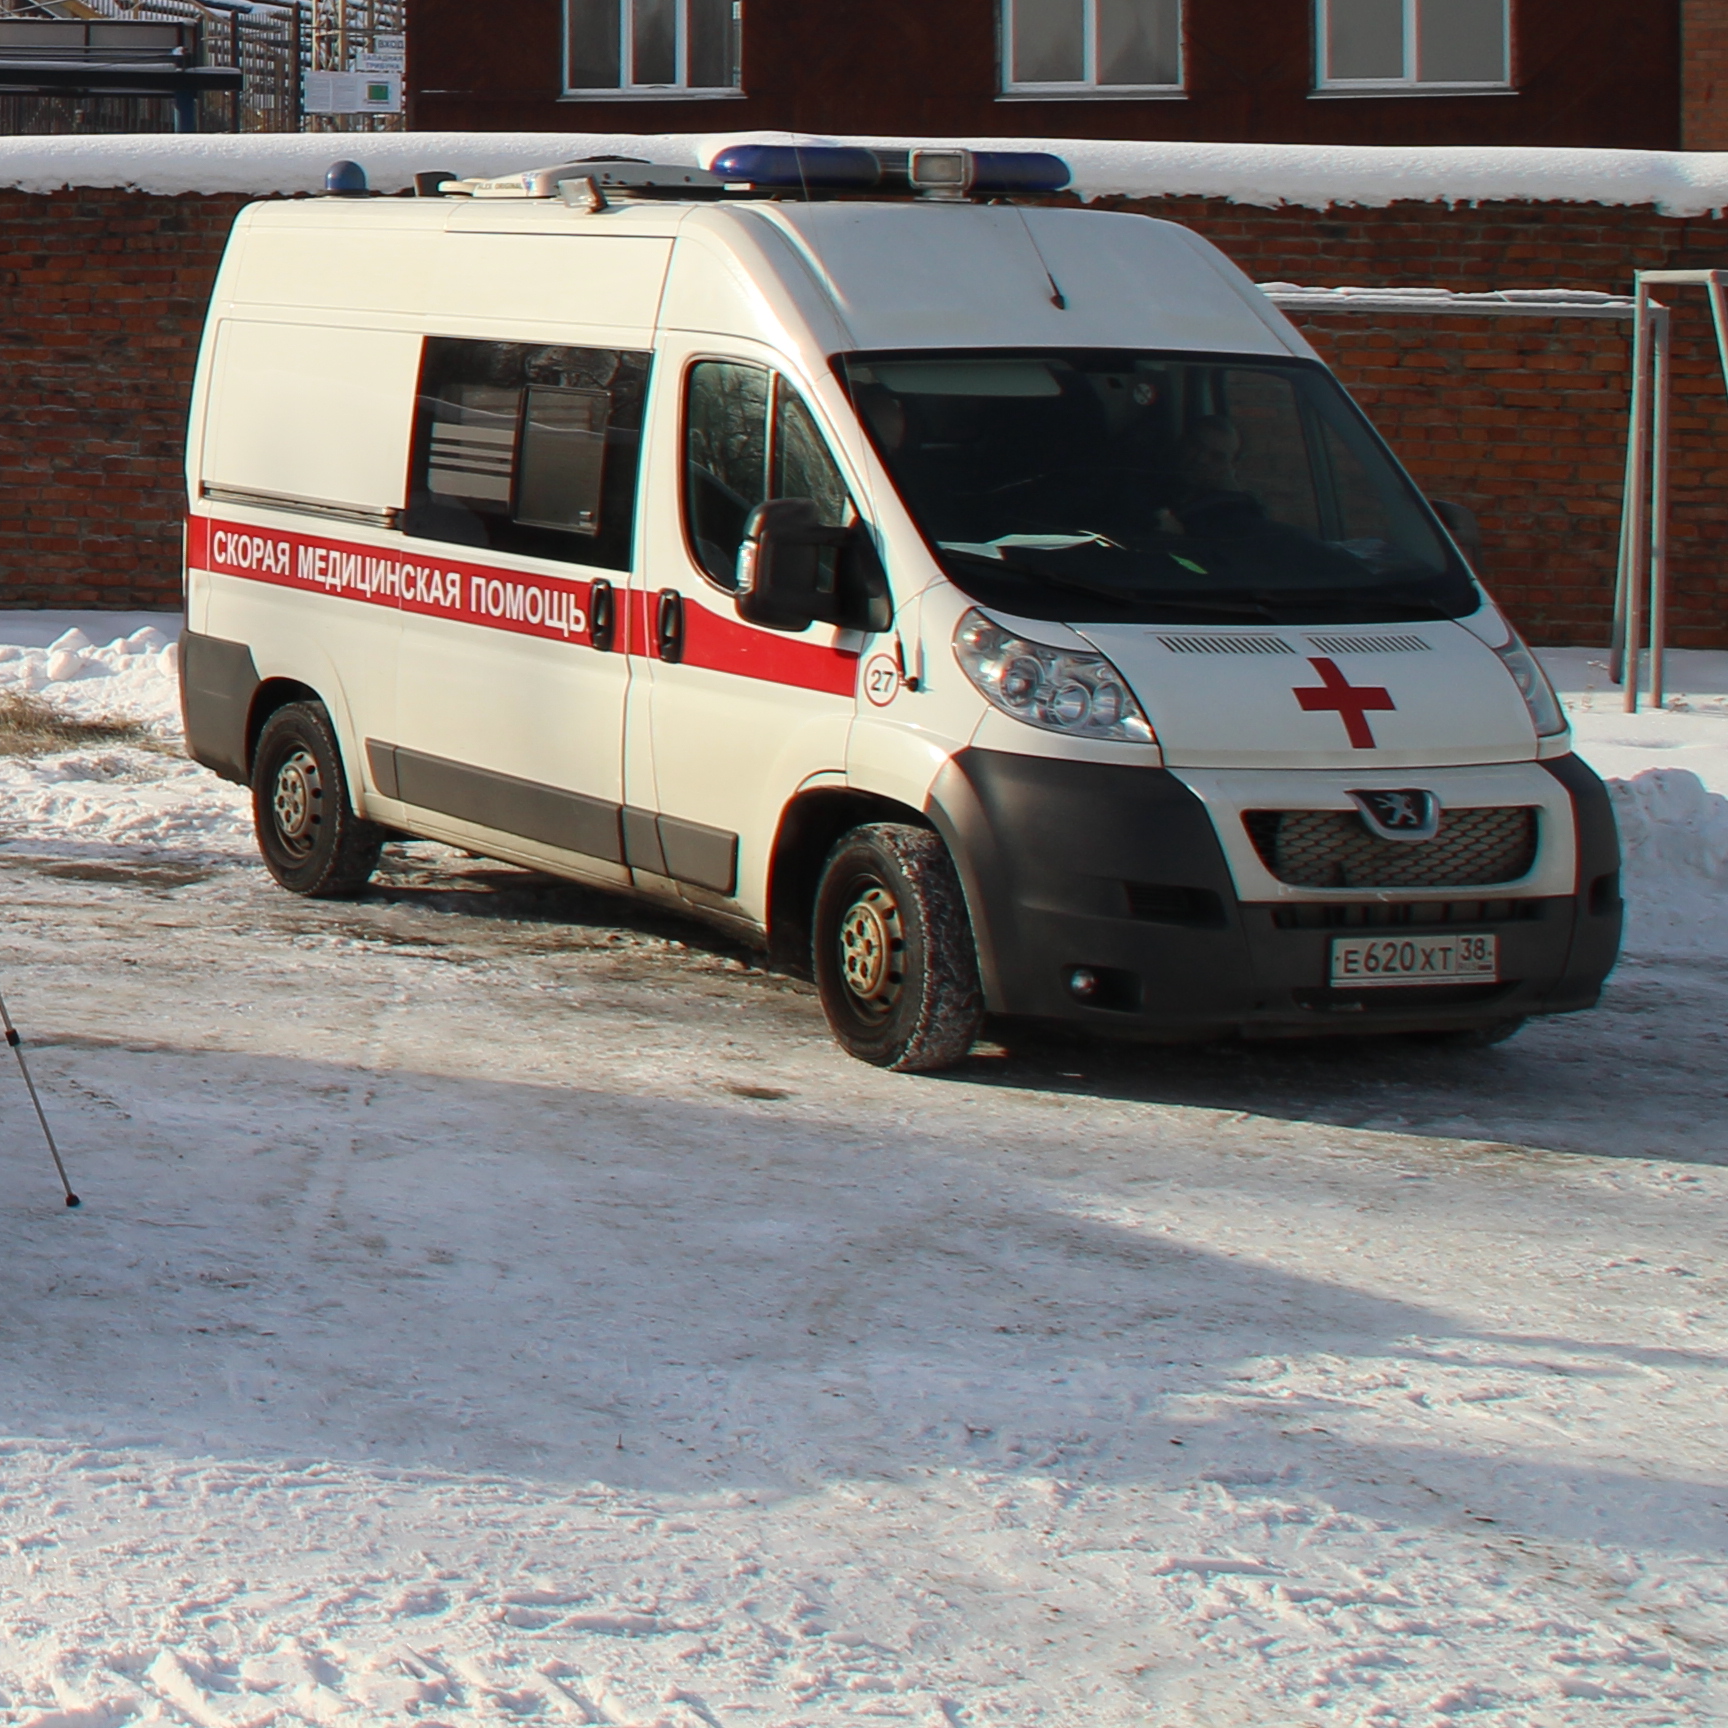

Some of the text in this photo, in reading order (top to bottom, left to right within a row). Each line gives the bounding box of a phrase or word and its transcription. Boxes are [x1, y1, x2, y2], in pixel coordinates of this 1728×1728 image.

[378, 39, 404, 50] ВХОД
[213, 530, 587, 638] СКОРАЯ МЕДИЦИНСКАЯ ПОМОЩЬ
[870, 669, 894, 692] 27
[1460, 937, 1485, 961] 38
